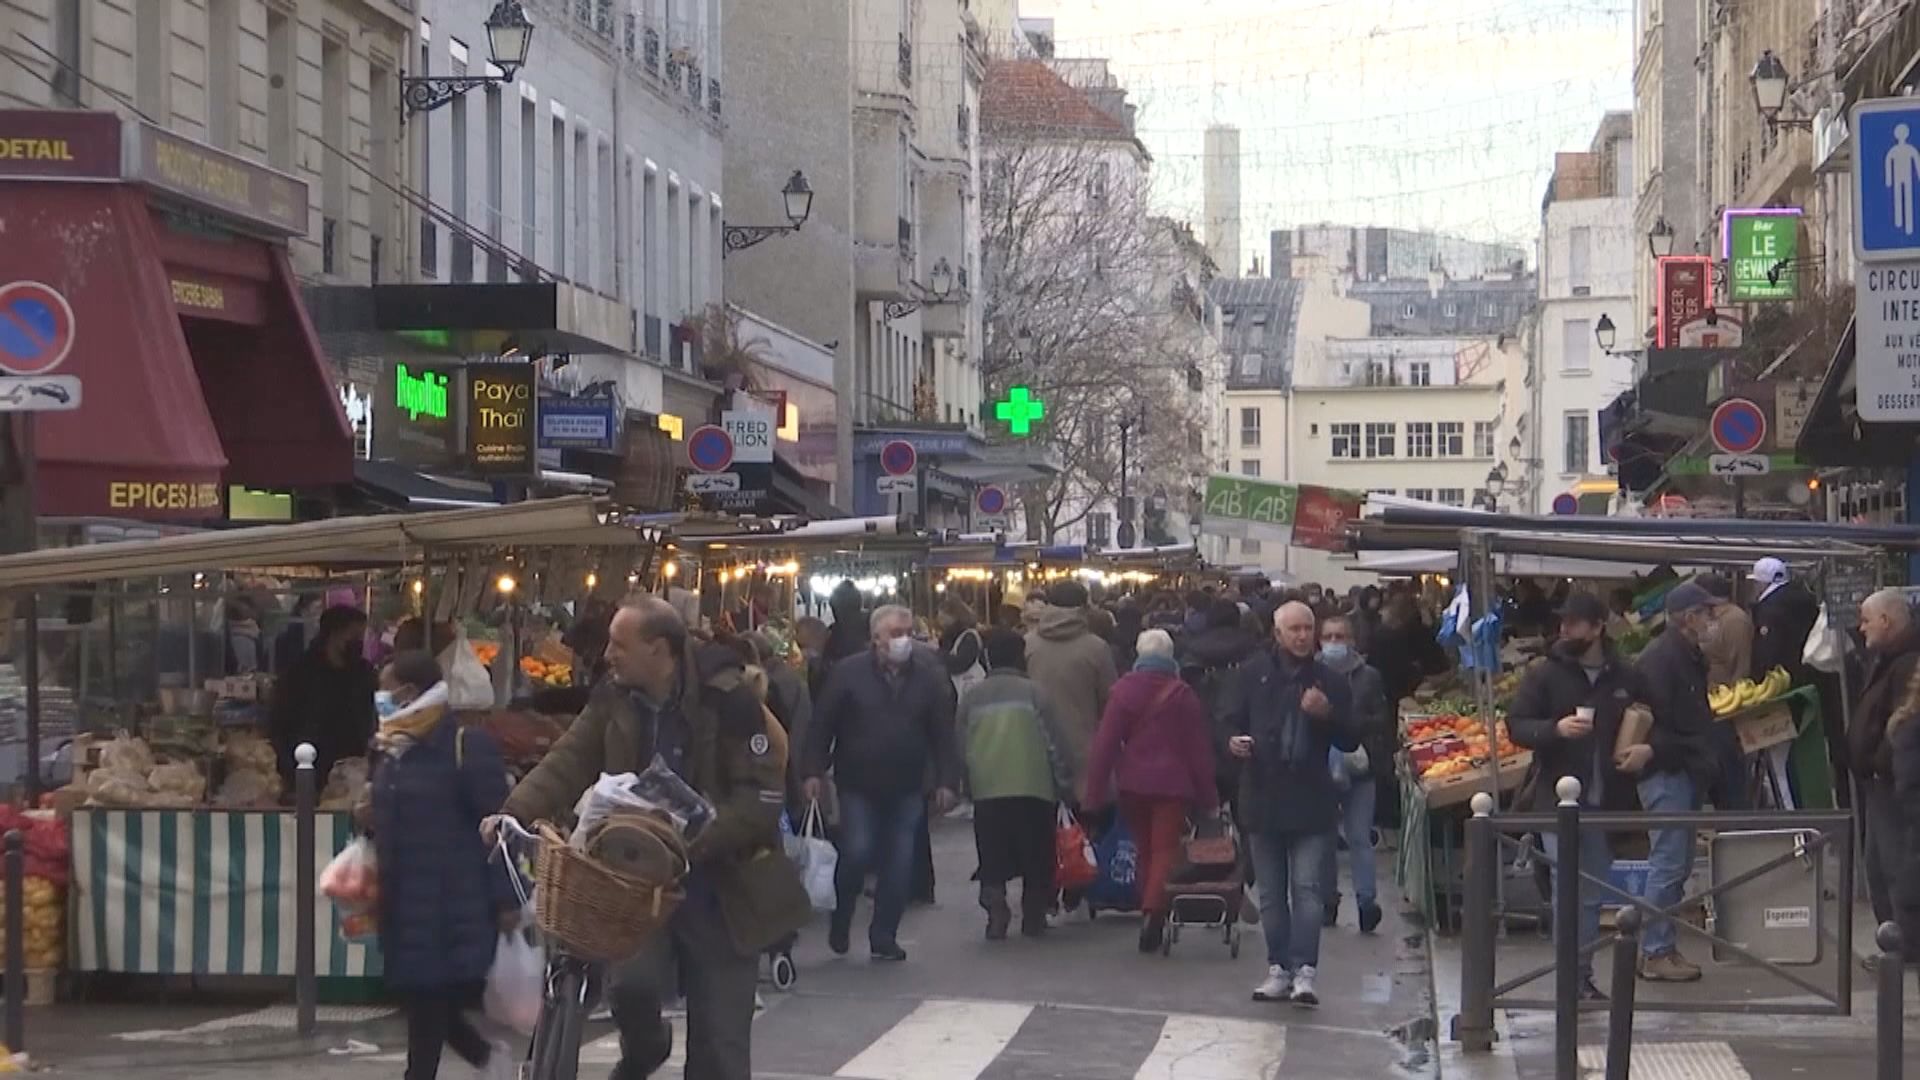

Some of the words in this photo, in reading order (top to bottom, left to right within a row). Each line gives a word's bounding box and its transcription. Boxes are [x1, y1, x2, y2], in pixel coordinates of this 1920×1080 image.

[1753, 220, 1774, 232] Bar
[1751, 235, 1776, 256] LE
[1883, 300, 1920, 321] INTE
[1884, 333, 1903, 348] AUX
[474, 380, 528, 404] Paya
[479, 408, 525, 428] Thaï
[726, 421, 768, 433] FRED
[109, 482, 188, 509] EPICES
[1765, 910, 1809, 921] Esperanto
